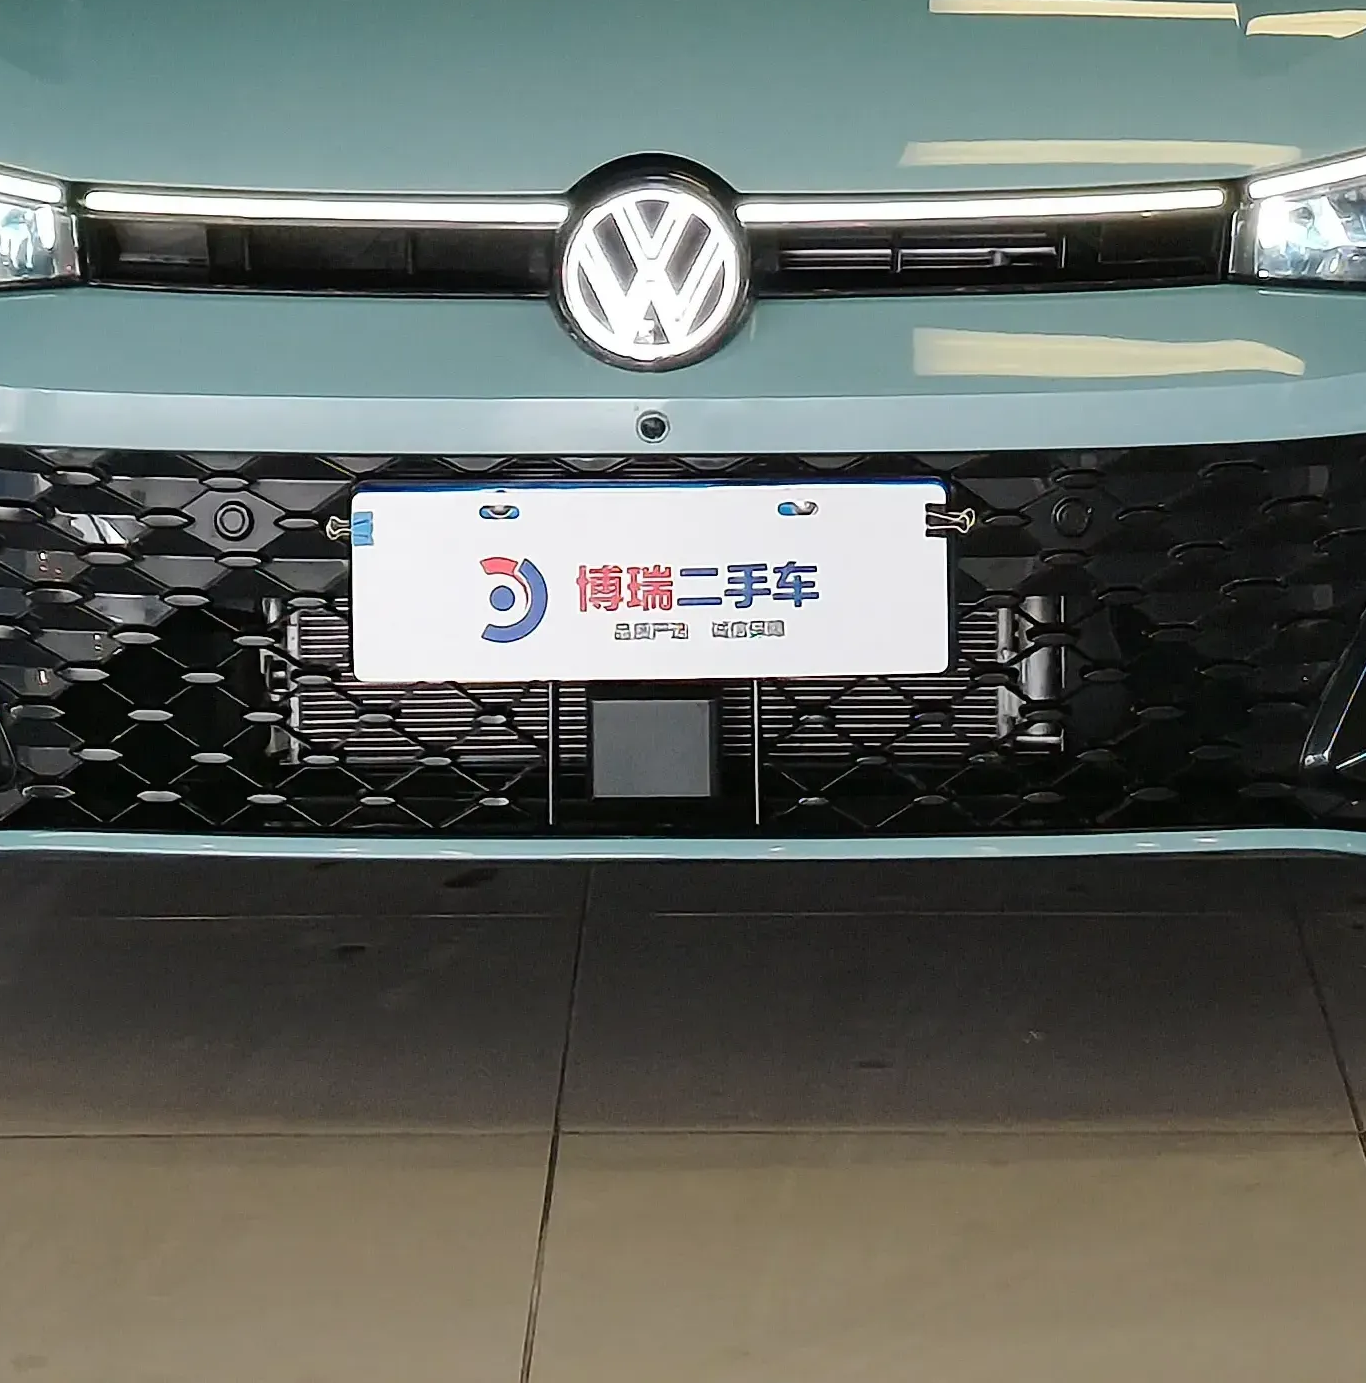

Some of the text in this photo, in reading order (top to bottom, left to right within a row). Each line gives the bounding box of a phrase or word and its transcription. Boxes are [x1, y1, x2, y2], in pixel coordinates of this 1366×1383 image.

[565, 191, 737, 360] VW
[576, 561, 820, 611] 博瑞二手车
